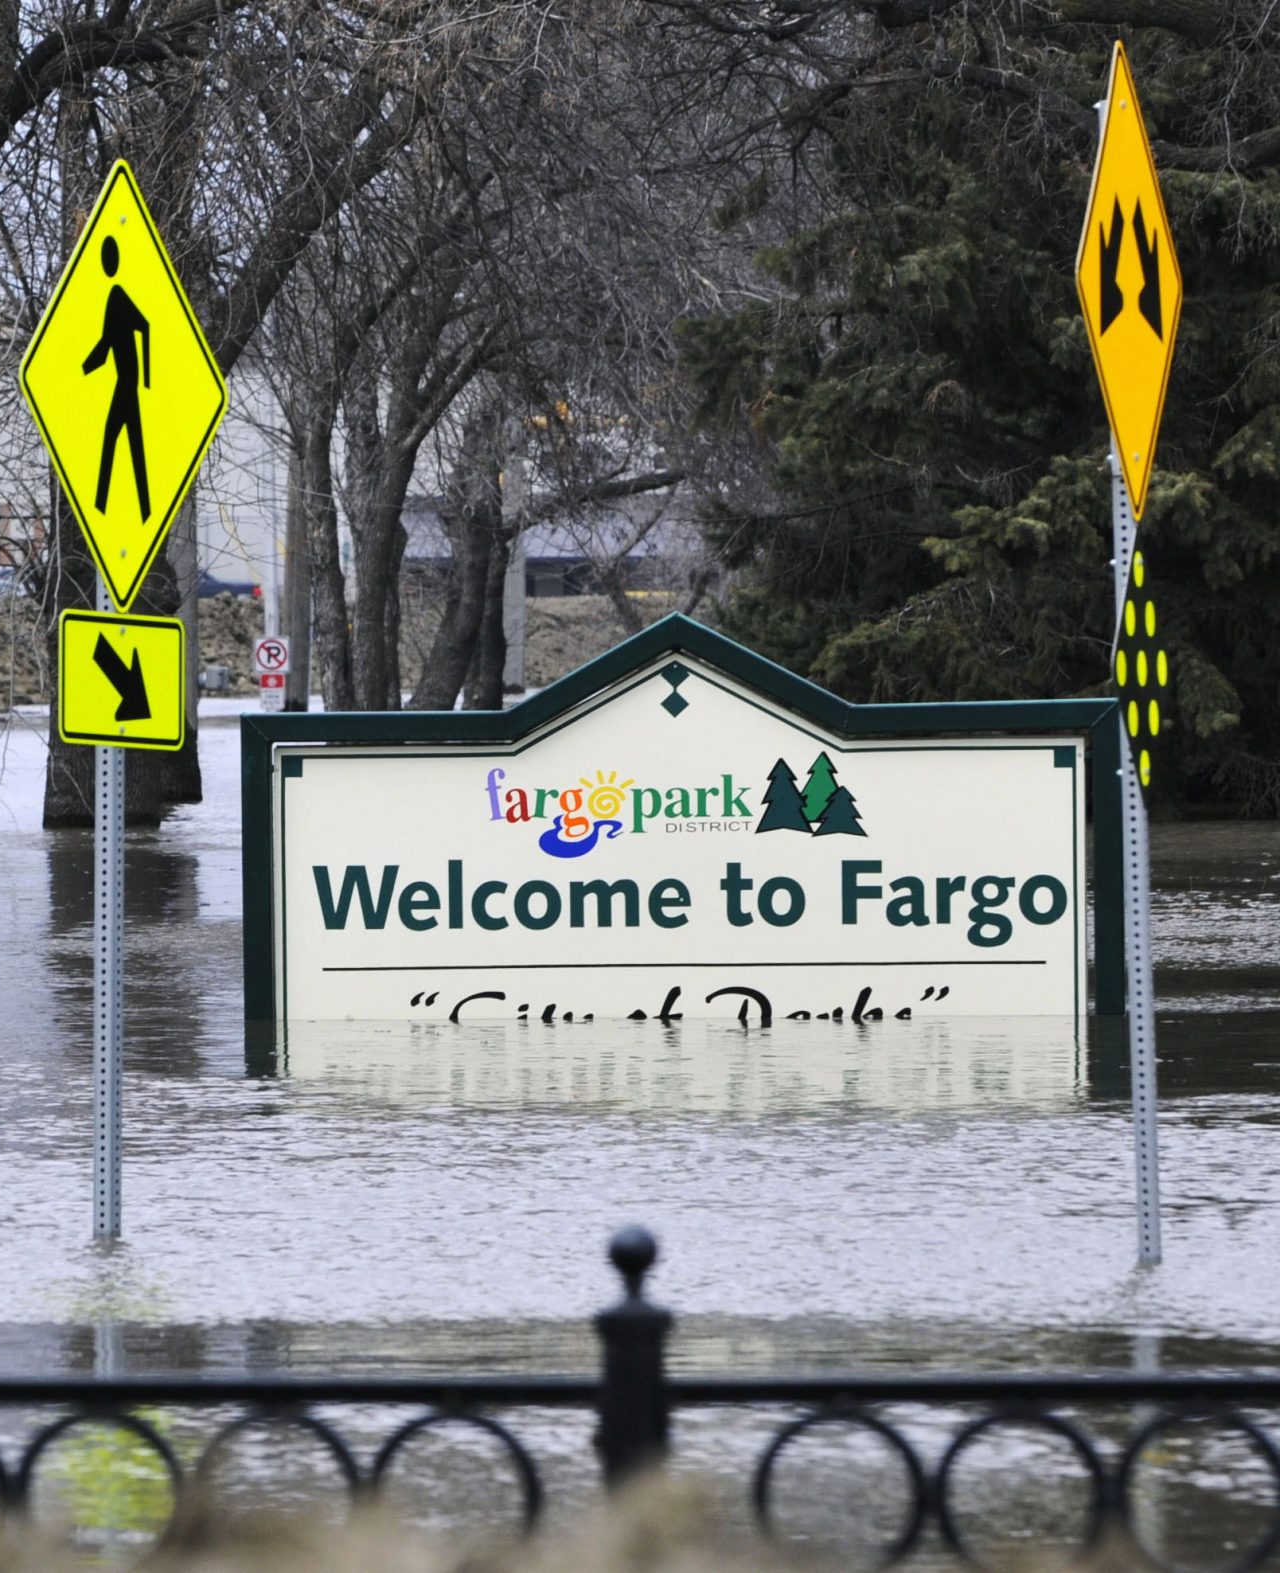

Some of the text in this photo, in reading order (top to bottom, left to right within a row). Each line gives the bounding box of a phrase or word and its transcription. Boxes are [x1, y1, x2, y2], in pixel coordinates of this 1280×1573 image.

[630, 774, 753, 833] park
[665, 820, 753, 834] DISTRICT
[312, 859, 1068, 948] Welcome to Fargo
